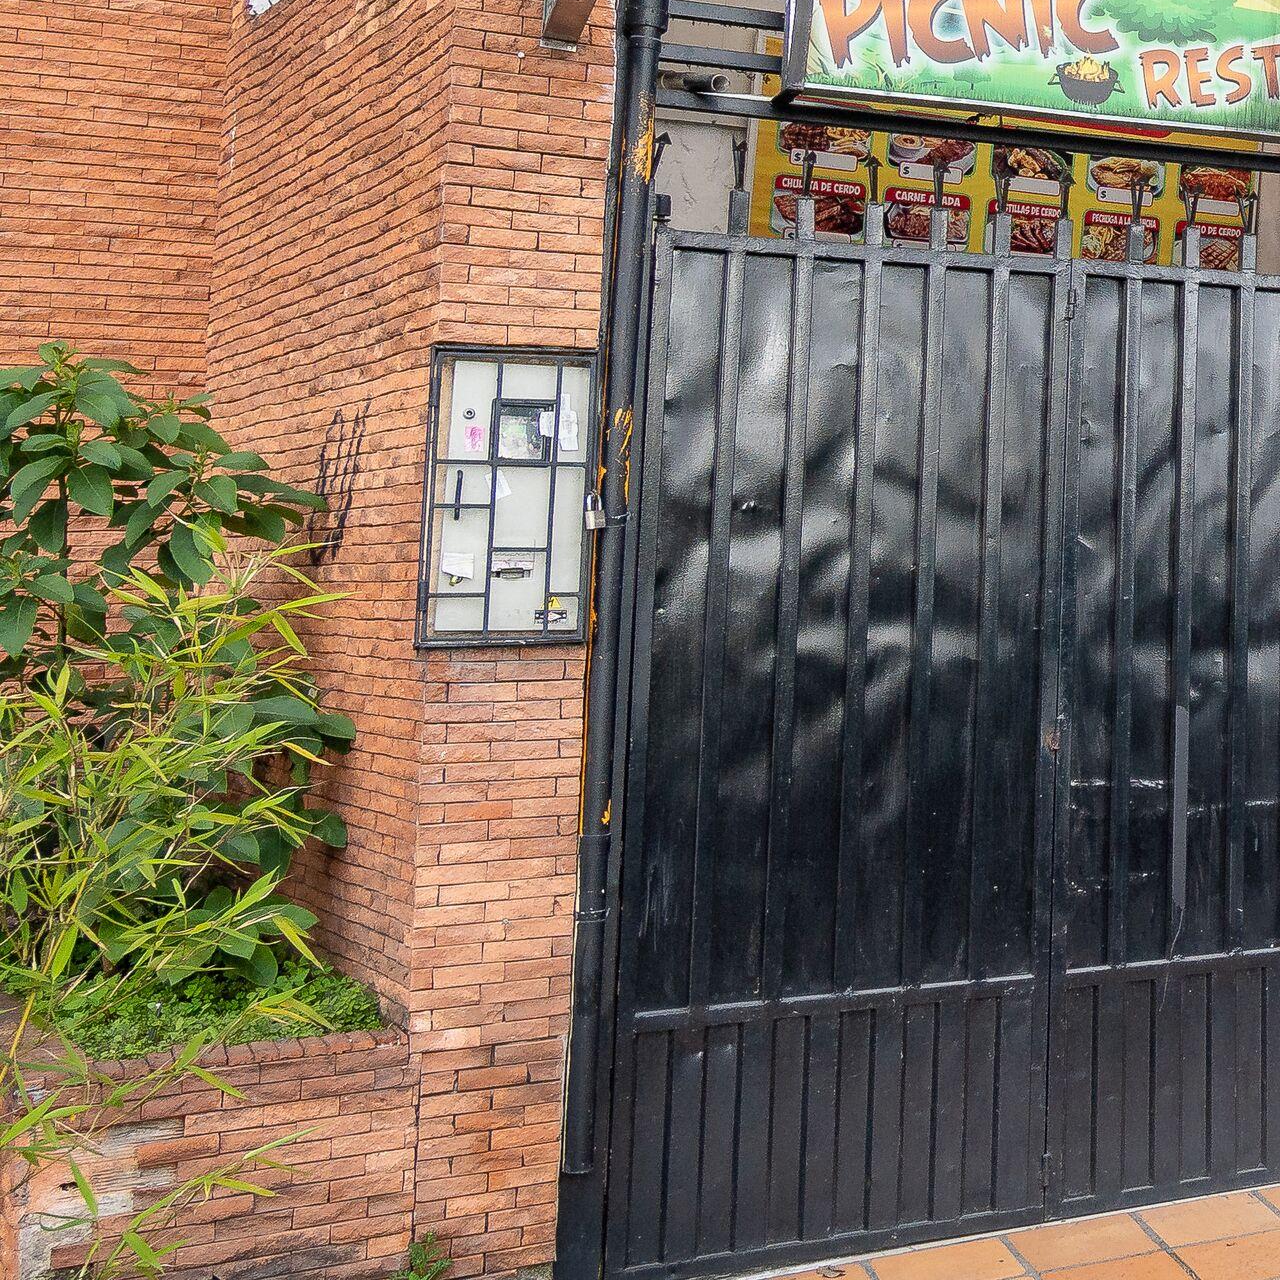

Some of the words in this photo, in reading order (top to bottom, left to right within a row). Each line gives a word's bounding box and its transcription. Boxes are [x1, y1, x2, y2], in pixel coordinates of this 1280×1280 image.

[821, 182, 832, 192] DE
[834, 183, 860, 195] CERDO
[895, 190, 926, 203] CARNE
[928, 194, 960, 207] AADA
[1031, 206, 1040, 216] DE
[1207, 226, 1217, 235] DE
[1218, 227, 1241, 238] CERDO
